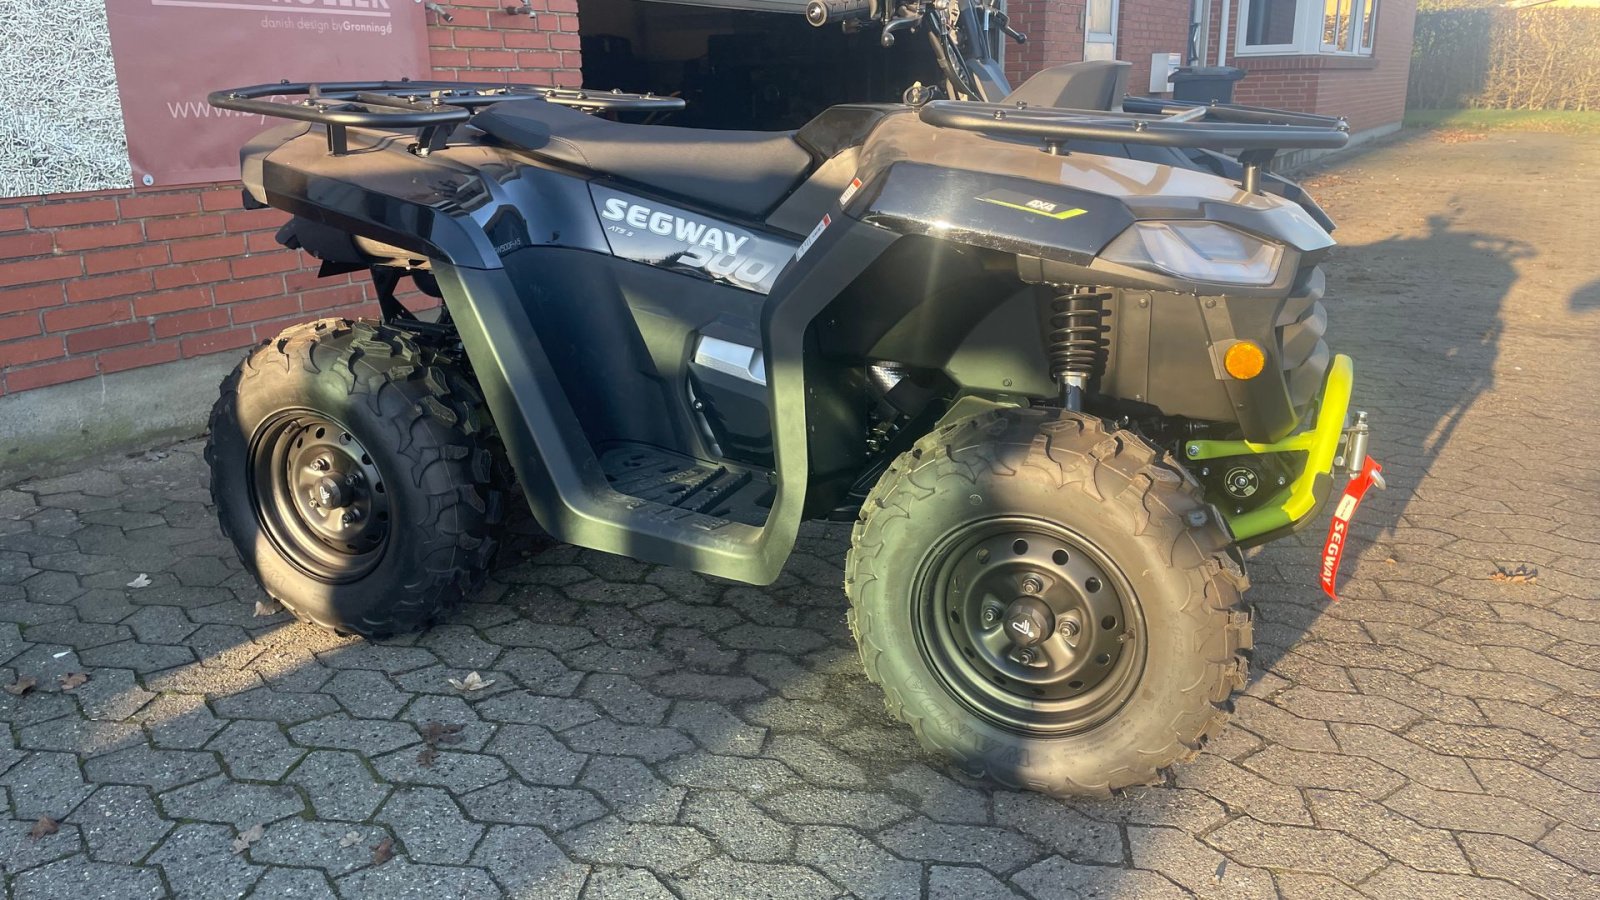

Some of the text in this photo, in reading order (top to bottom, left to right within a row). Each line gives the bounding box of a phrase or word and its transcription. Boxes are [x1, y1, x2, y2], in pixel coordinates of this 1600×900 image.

[260, 15, 295, 28] danish
[297, 17, 330, 33] design
[601, 197, 749, 257] SEGWAY
[1322, 520, 1345, 586] SEGWAY
